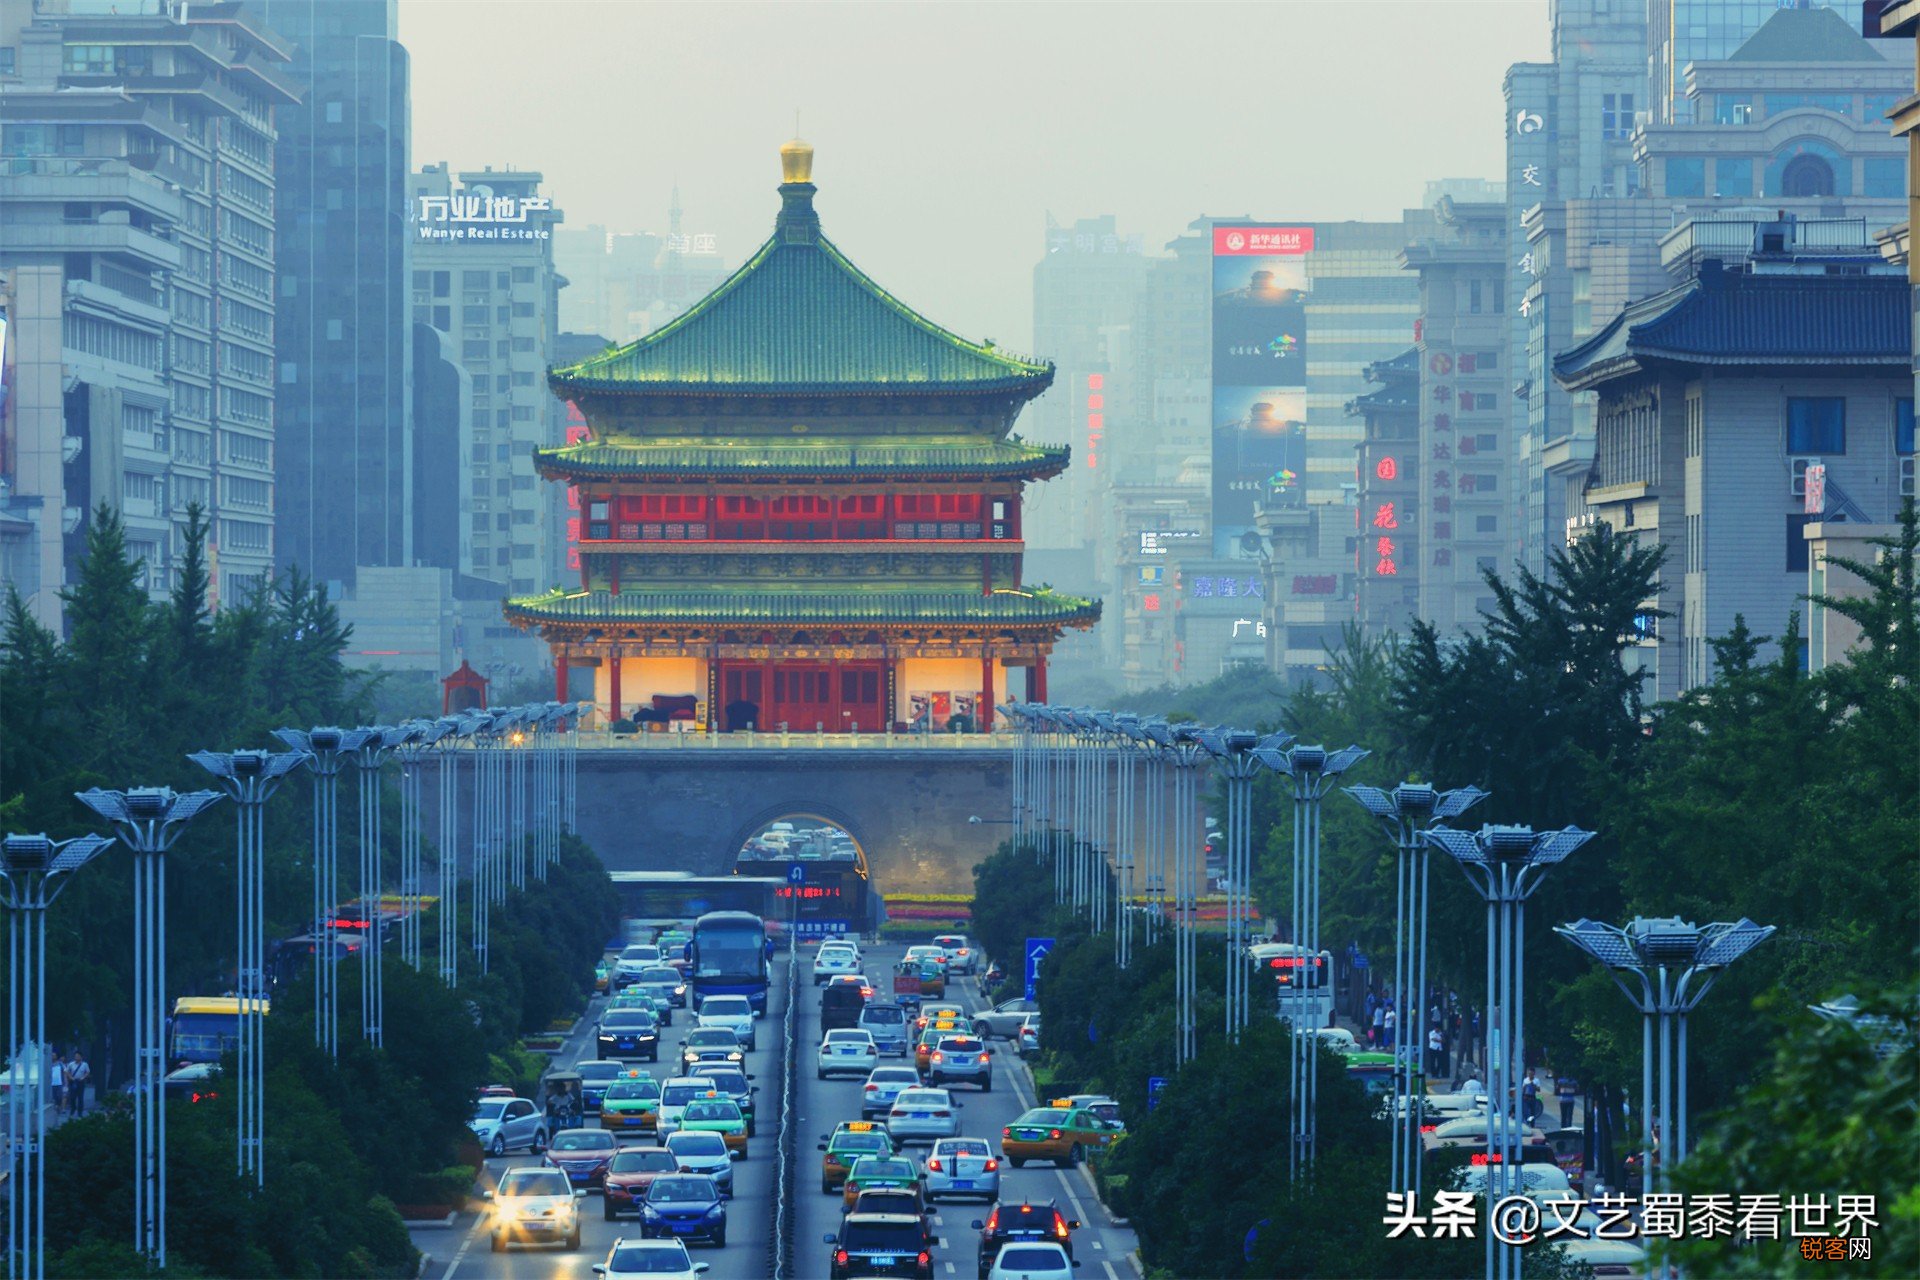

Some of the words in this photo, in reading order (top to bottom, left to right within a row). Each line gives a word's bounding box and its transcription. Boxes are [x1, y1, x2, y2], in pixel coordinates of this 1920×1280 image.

[419, 195, 550, 222] 万业地产
[419, 227, 464, 240] Wanye
[468, 227, 498, 239] Real
[501, 227, 549, 240] Estate
